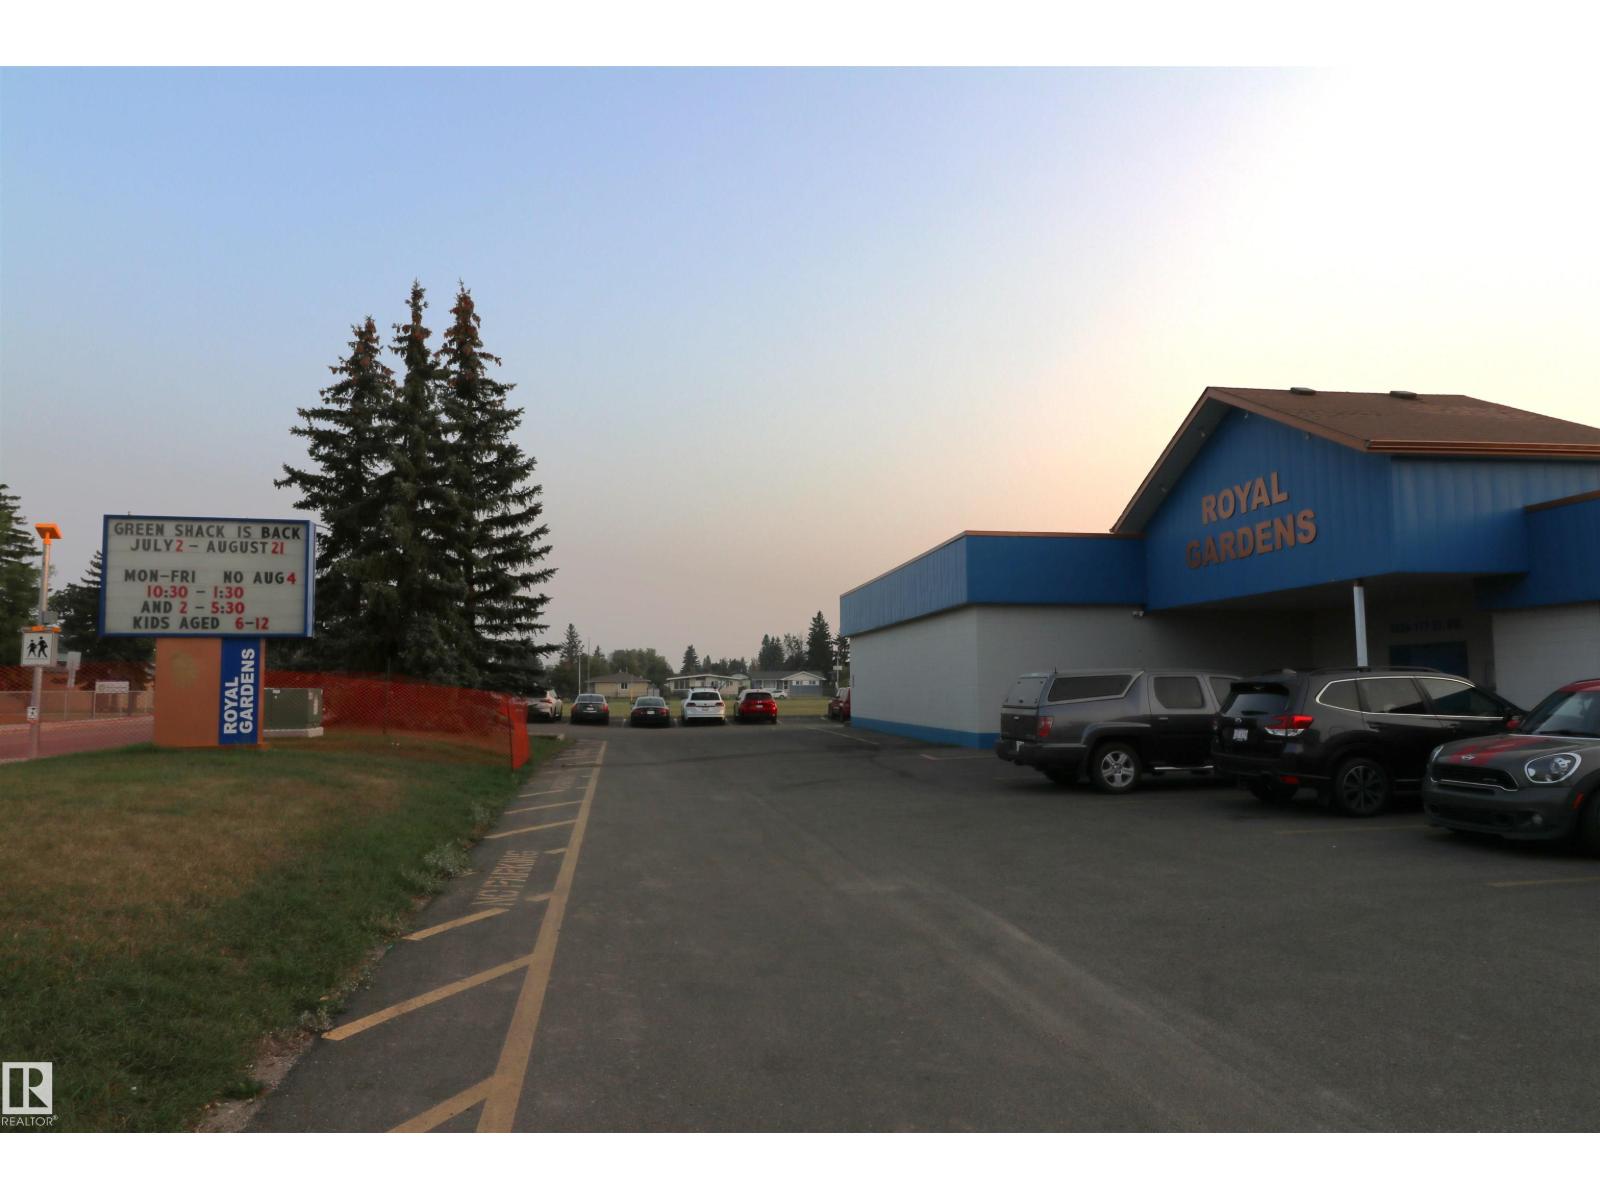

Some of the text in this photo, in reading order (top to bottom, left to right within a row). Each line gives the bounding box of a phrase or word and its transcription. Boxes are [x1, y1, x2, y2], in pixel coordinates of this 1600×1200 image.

[1201, 471, 1289, 526] ROYAL
[114, 522, 301, 540] GREEN SHACK IS BACK
[1186, 508, 1317, 569] GARDENS
[223, 571, 244, 584] NO
[146, 585, 188, 598] 10:30
[213, 586, 244, 599] 1:30
[141, 600, 173, 614] AND
[179, 601, 188, 614] 2
[211, 601, 245, 614] 5:30
[133, 616, 270, 630] KIDS AGED 6-12
[239, 647, 256, 734] GARDENS
[223, 676, 239, 734] ROYAL
